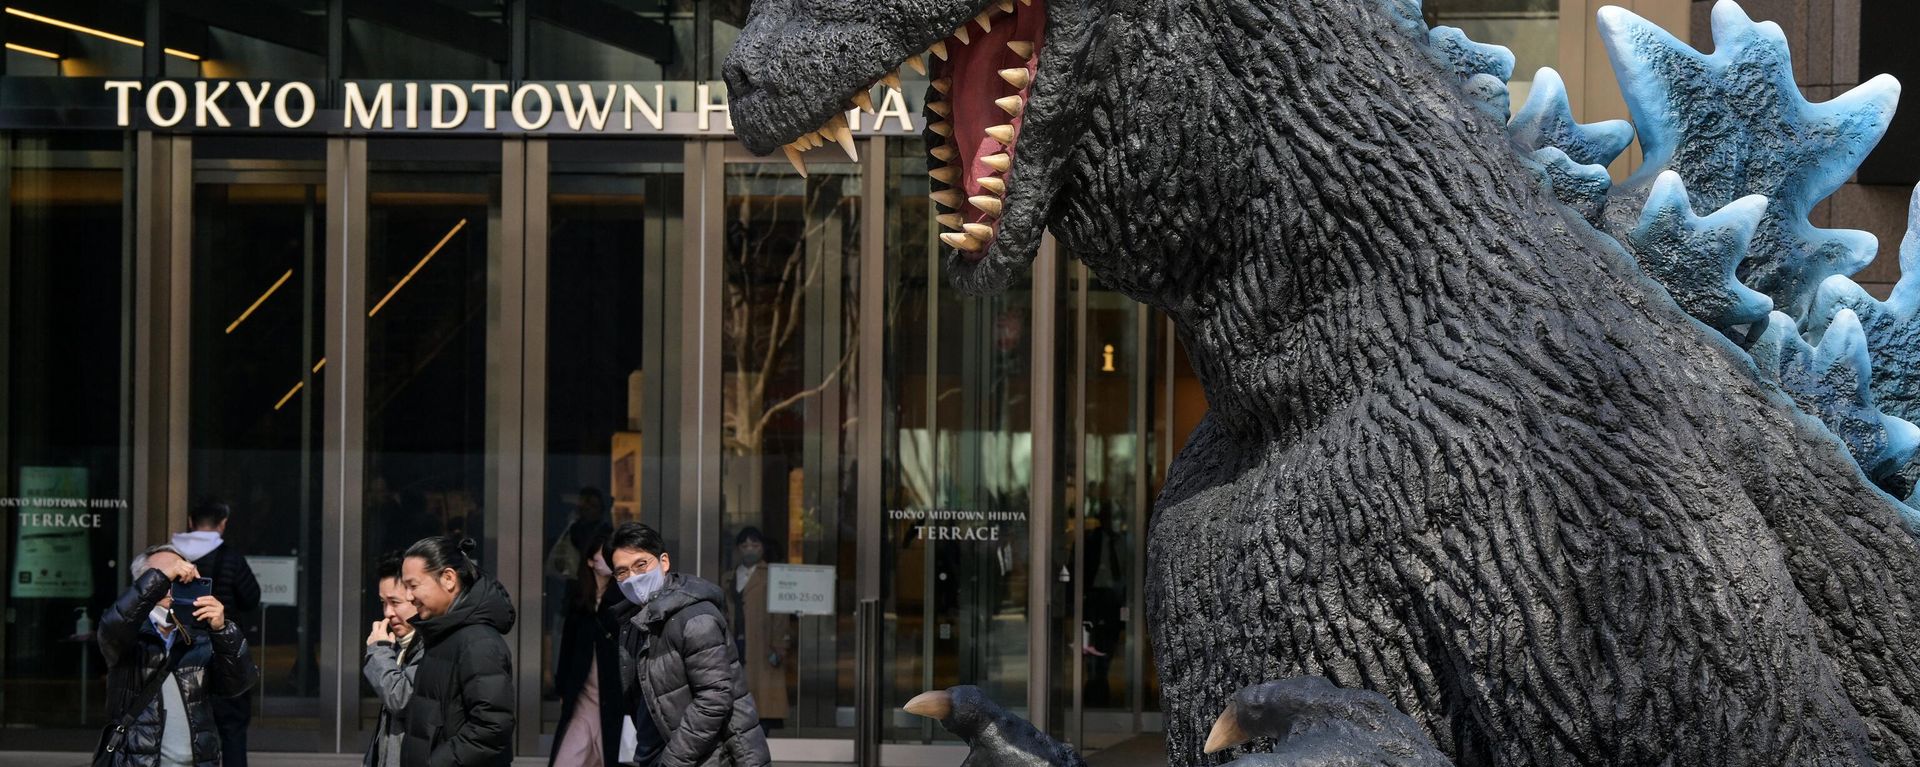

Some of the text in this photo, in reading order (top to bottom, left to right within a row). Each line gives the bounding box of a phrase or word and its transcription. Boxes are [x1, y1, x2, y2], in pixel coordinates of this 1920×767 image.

[104, 81, 316, 128] TOKYO
[344, 82, 664, 131] MIDTOWN
[0, 497, 128, 509] OKYO MIDTOWN HIBIYA
[19, 512, 101, 528] TERRACE
[888, 510, 1026, 521] TOKYO MIDTOWN HIBIYA
[914, 525, 999, 541] TERRACE
